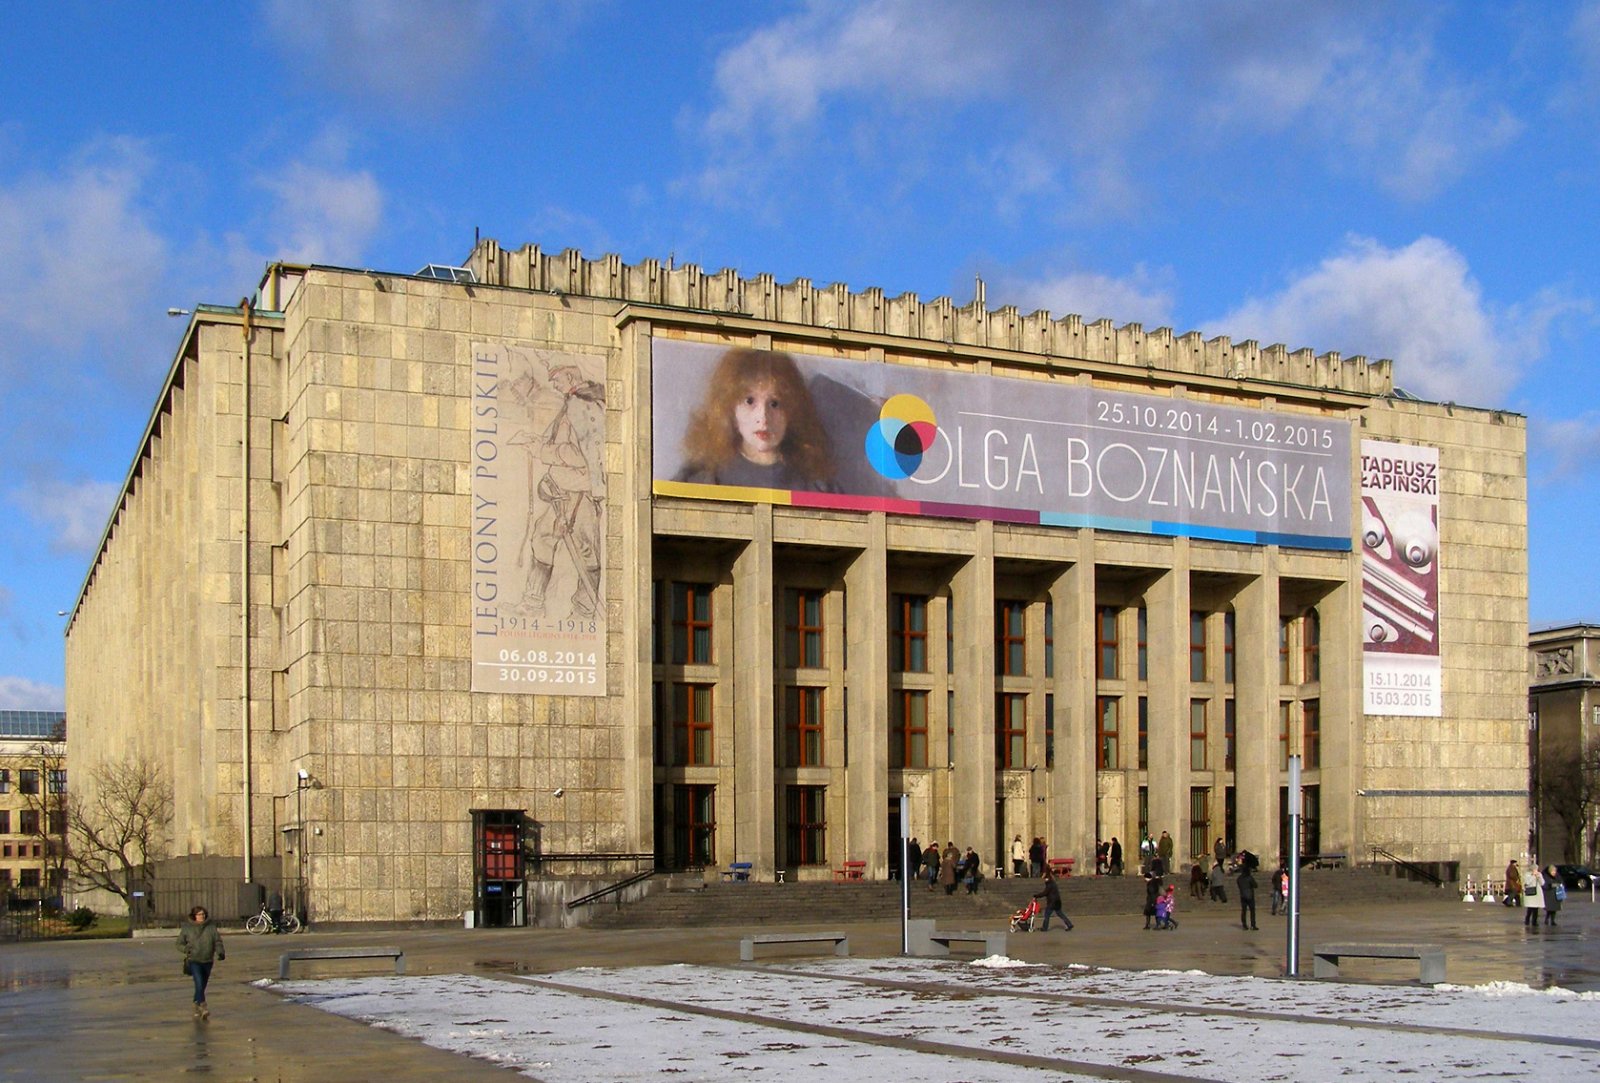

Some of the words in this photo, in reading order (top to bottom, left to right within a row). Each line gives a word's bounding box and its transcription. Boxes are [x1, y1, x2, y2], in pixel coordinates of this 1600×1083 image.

[475, 352, 498, 479] POLSKIE
[909, 426, 1044, 494] OLGA
[1067, 438, 1333, 522] BOZNAŃSKA
[1361, 455, 1437, 479] TADEUSZ
[475, 493, 498, 637] LEGIONY
[499, 649, 597, 665] 06.08.2014
[499, 668, 597, 684] 30.09.2015
[1370, 672, 1431, 687] 15.11.2014
[1370, 691, 1432, 707] 15.03.2015
